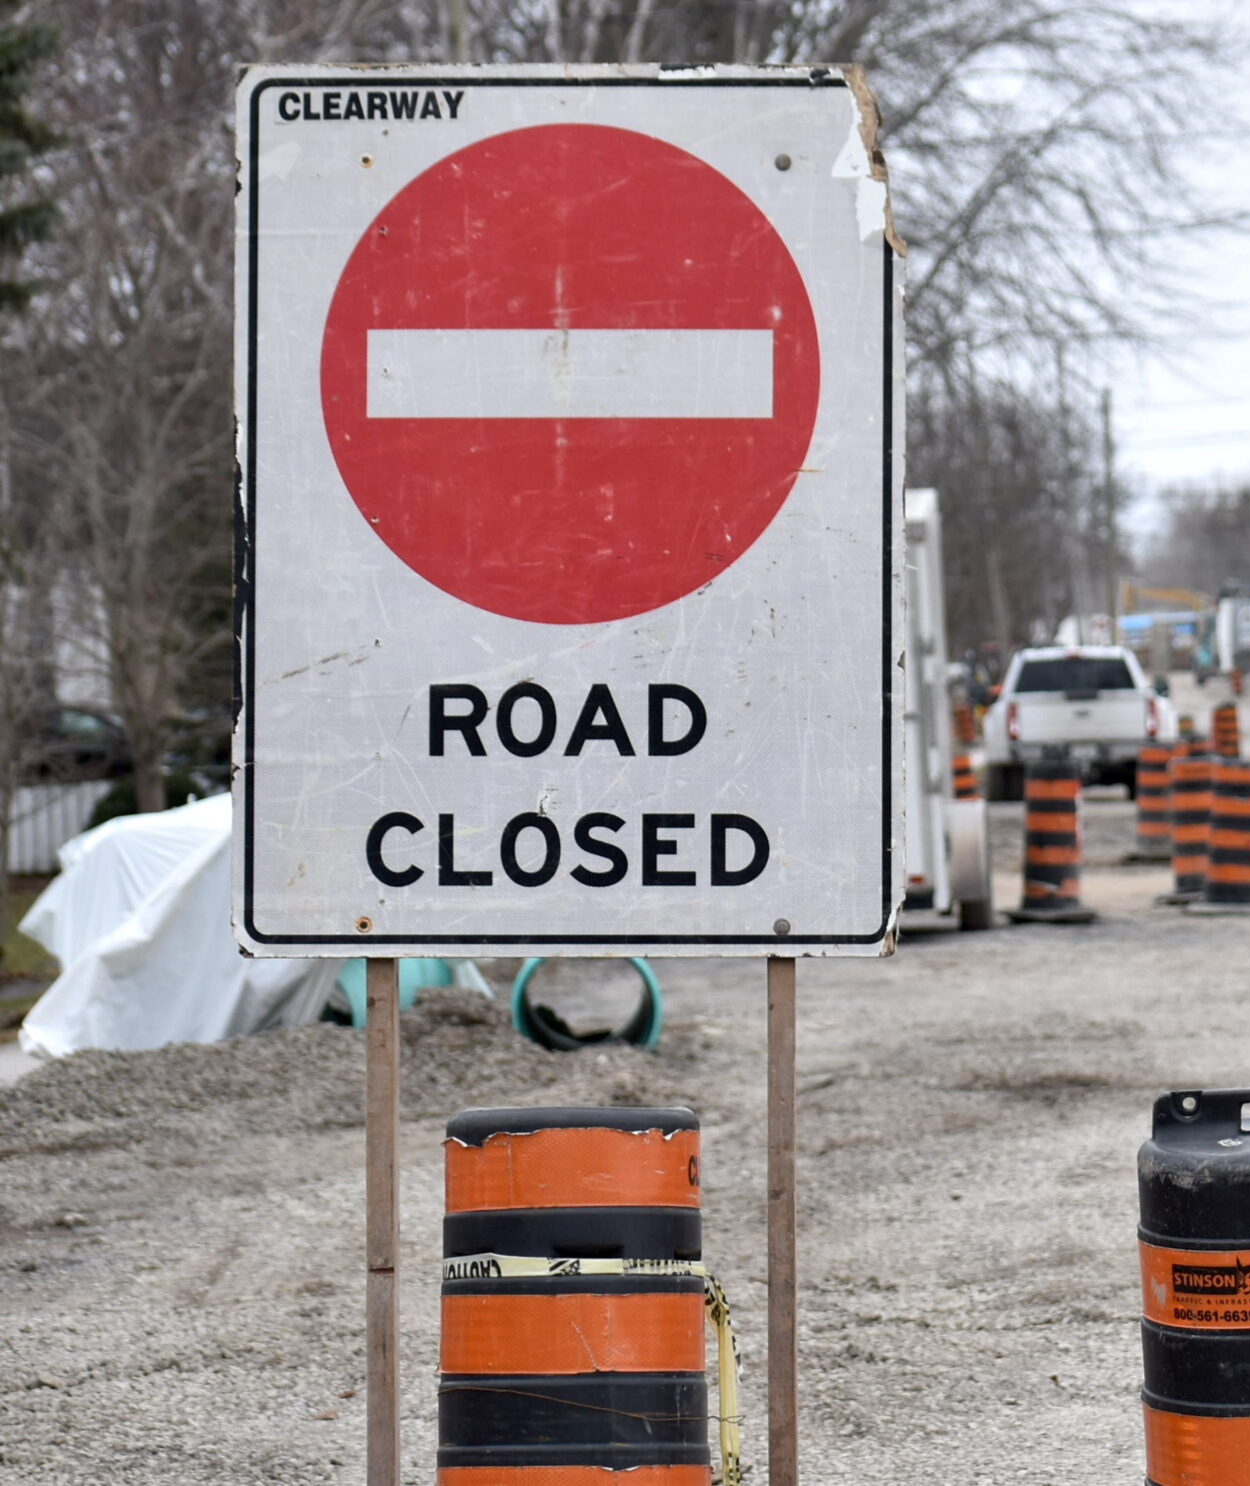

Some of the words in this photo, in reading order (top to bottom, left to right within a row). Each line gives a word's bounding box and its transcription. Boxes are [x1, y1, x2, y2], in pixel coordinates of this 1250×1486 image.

[278, 91, 465, 122] CLEARWAY
[429, 681, 708, 758] ROAD
[365, 811, 770, 888] CLOSED
[1174, 1271, 1236, 1288] STINSON
[1206, 1297, 1212, 1305] &
